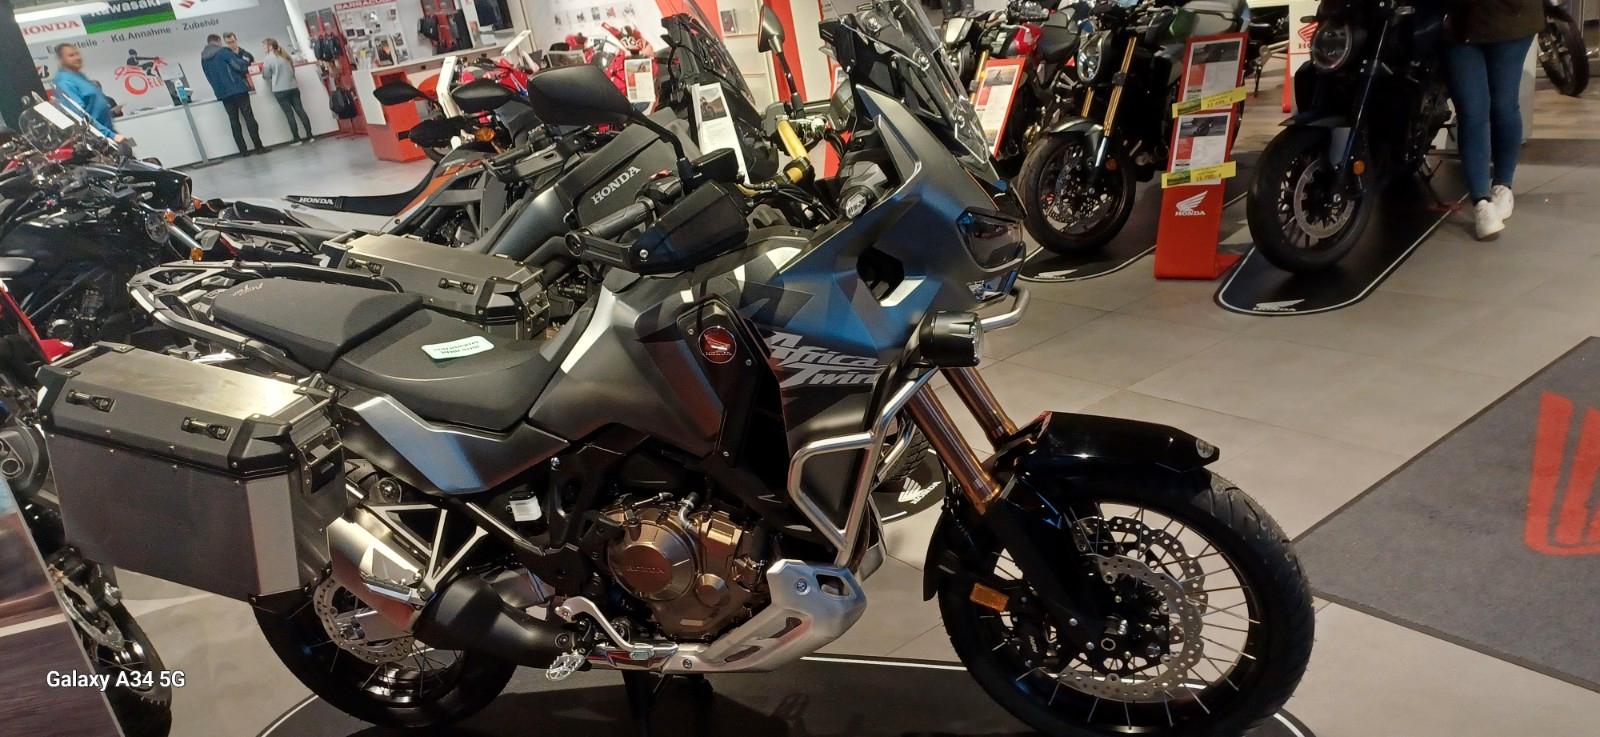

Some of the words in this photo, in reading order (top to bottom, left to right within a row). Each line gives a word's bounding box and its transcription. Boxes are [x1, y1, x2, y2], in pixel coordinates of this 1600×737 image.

[299, 196, 334, 205] HONDA
[591, 166, 641, 205] HONDA
[764, 330, 880, 367] Africa
[780, 362, 882, 389] Twin
